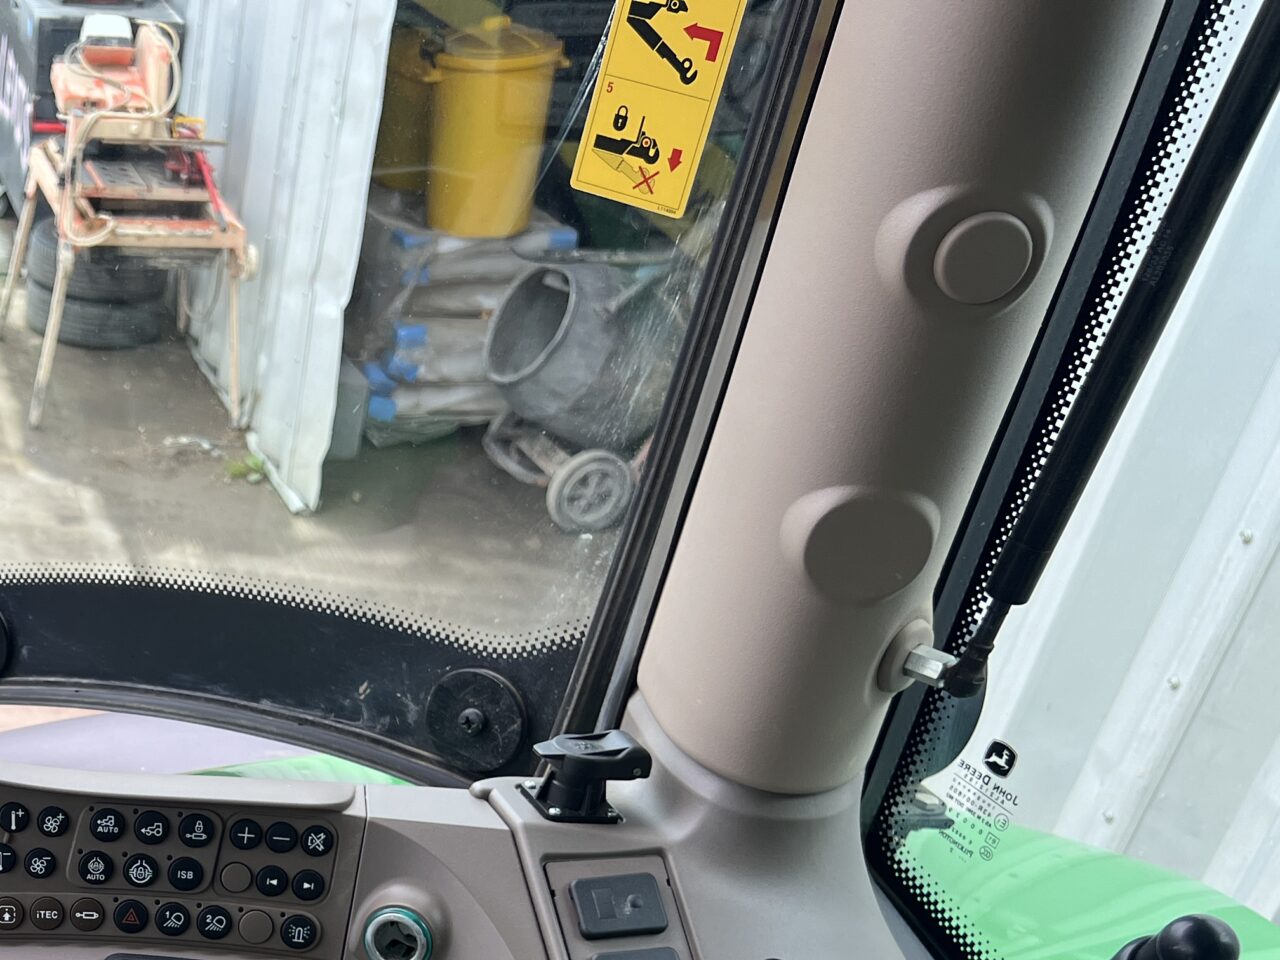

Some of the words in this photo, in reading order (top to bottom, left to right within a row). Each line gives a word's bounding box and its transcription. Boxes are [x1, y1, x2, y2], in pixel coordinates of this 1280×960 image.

[606, 82, 614, 93] 5
[96, 826, 119, 834] AUTO
[86, 873, 105, 881] AUTO
[177, 870, 194, 880] ISB
[36, 910, 59, 920] iTEC
[164, 909, 170, 919] 1
[205, 914, 212, 923] 2
